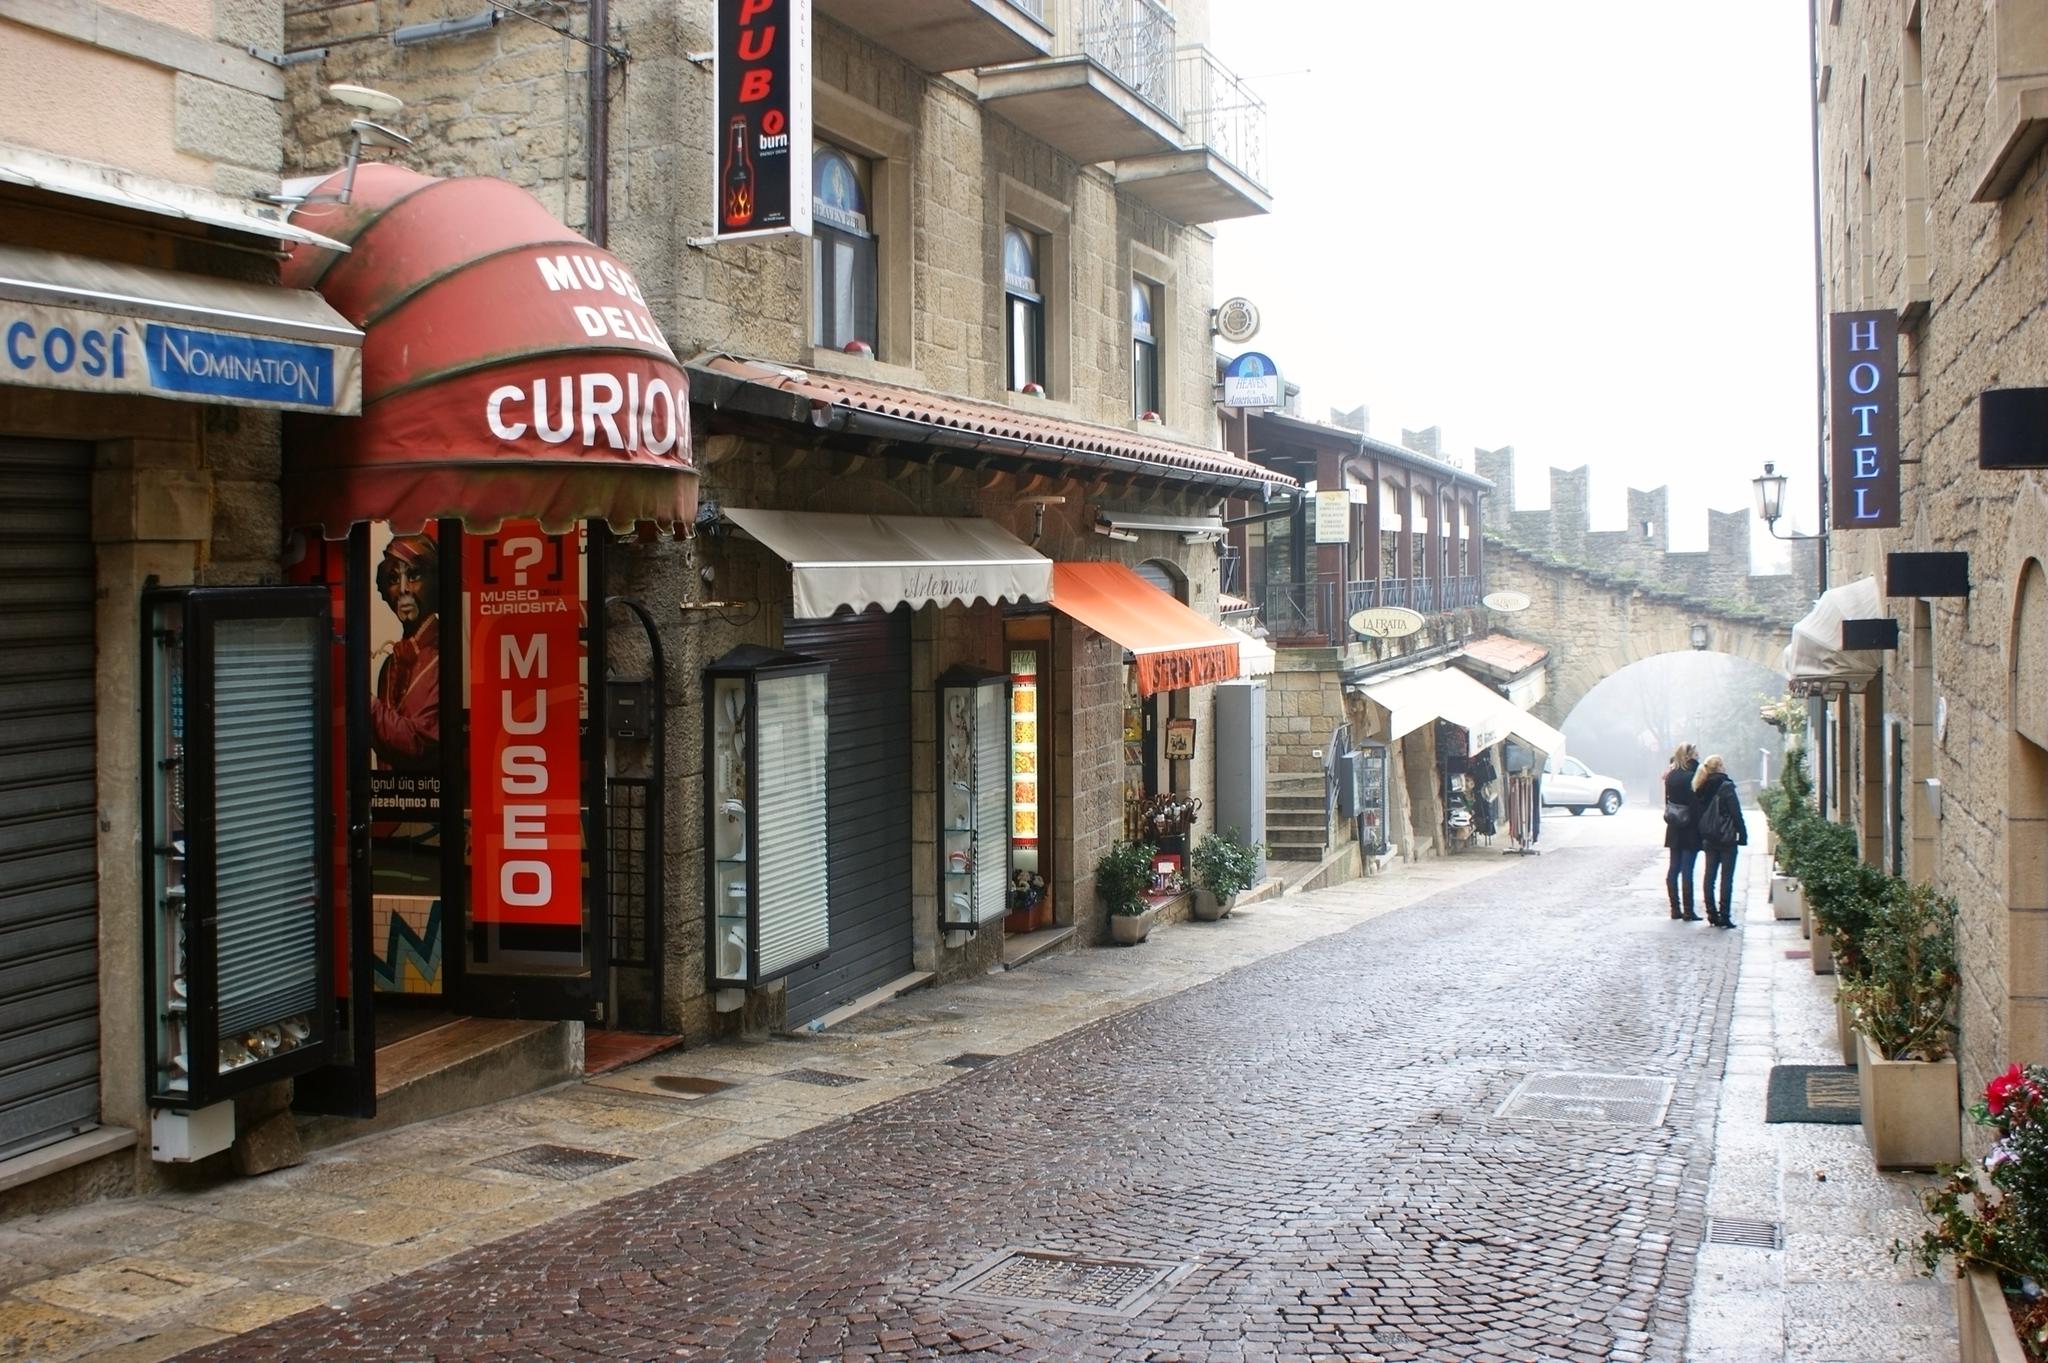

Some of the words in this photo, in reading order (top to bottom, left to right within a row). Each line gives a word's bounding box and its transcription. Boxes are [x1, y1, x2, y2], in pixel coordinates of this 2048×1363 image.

[738, 0, 776, 103] PUB
[759, 133, 788, 150] burn
[7, 321, 130, 378] COSÌ
[1849, 319, 1880, 519] HOTEL
[480, 589, 539, 602] MUSEO
[904, 571, 977, 598] Artemisia
[480, 598, 568, 615] CURIOSITÀ
[1363, 618, 1374, 630] LA
[1375, 618, 1407, 631] FRATTA
[1012, 651, 1036, 663] PIZZA
[500, 633, 552, 906] MUSEO
